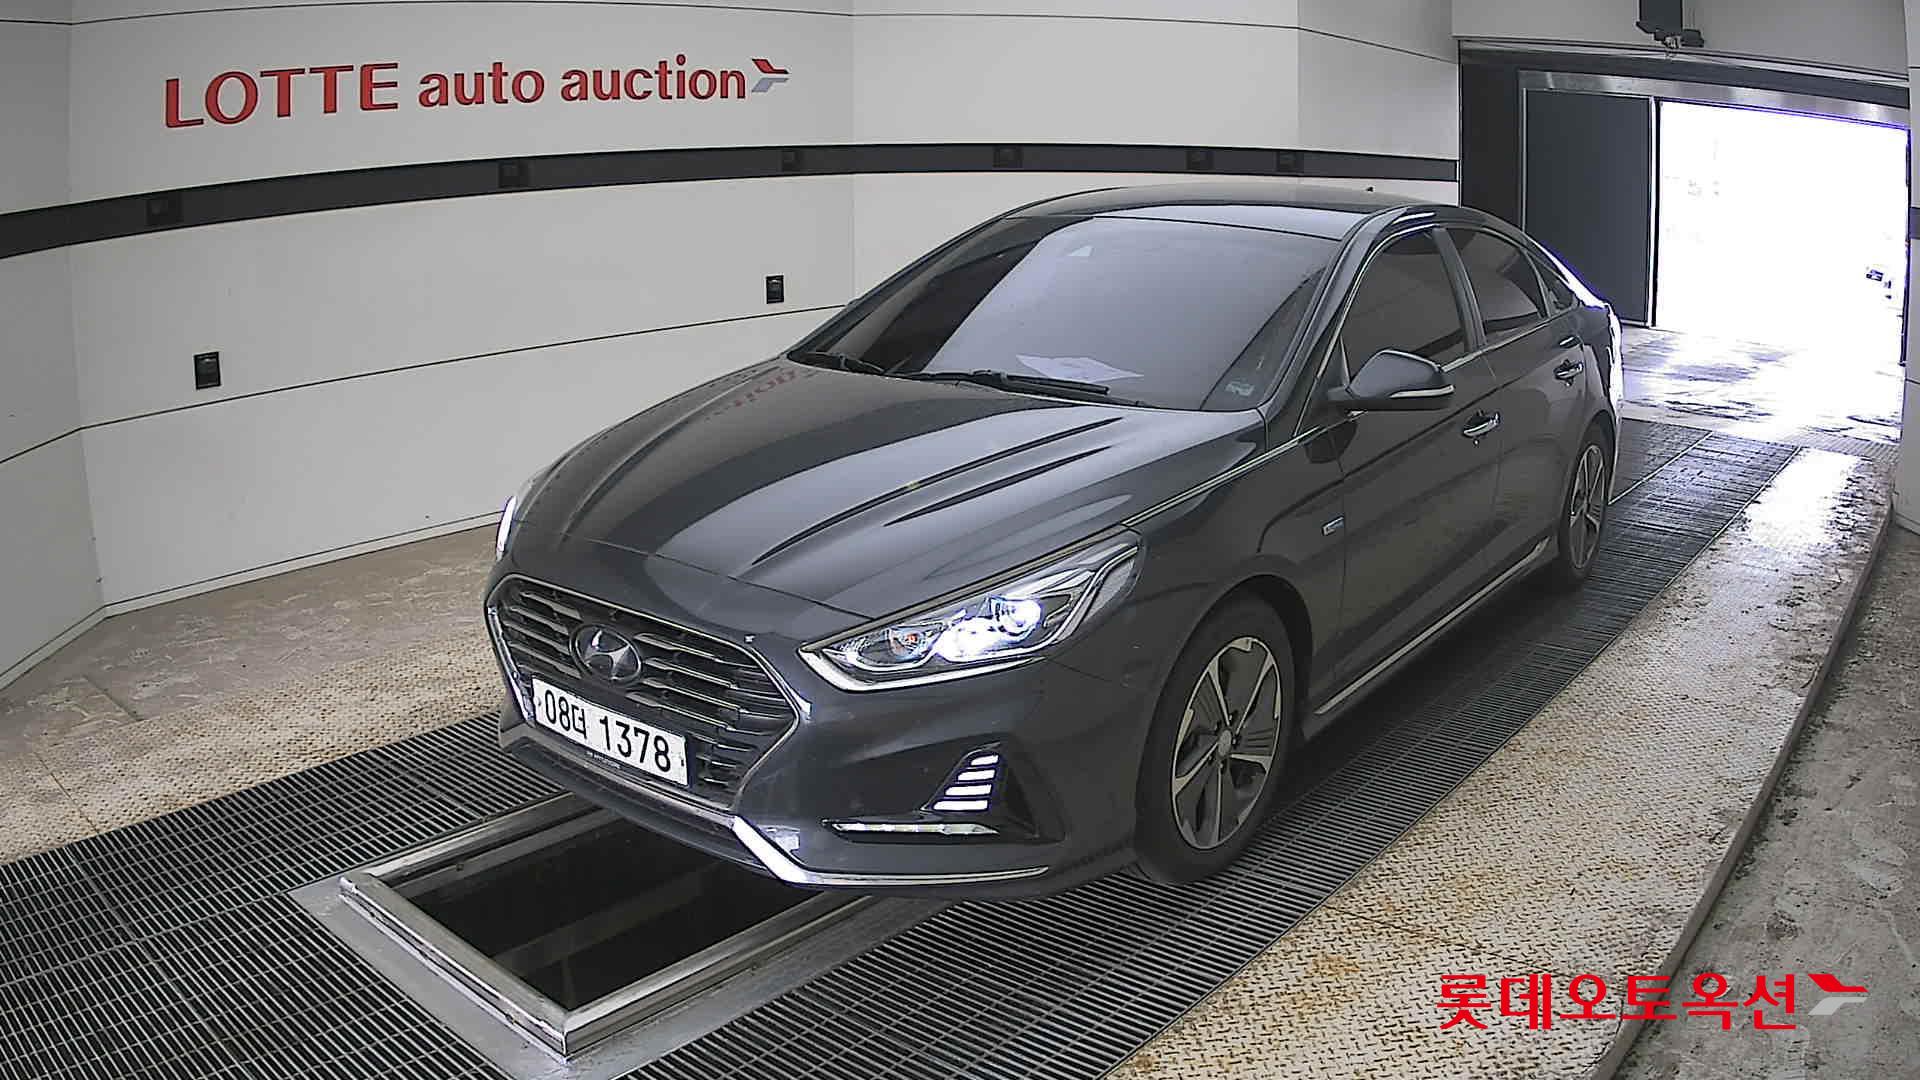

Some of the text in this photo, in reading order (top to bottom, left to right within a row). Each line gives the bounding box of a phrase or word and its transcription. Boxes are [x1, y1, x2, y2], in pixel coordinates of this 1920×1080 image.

[165, 54, 748, 128] LOTTE auto auction
[600, 715, 672, 773] 1378
